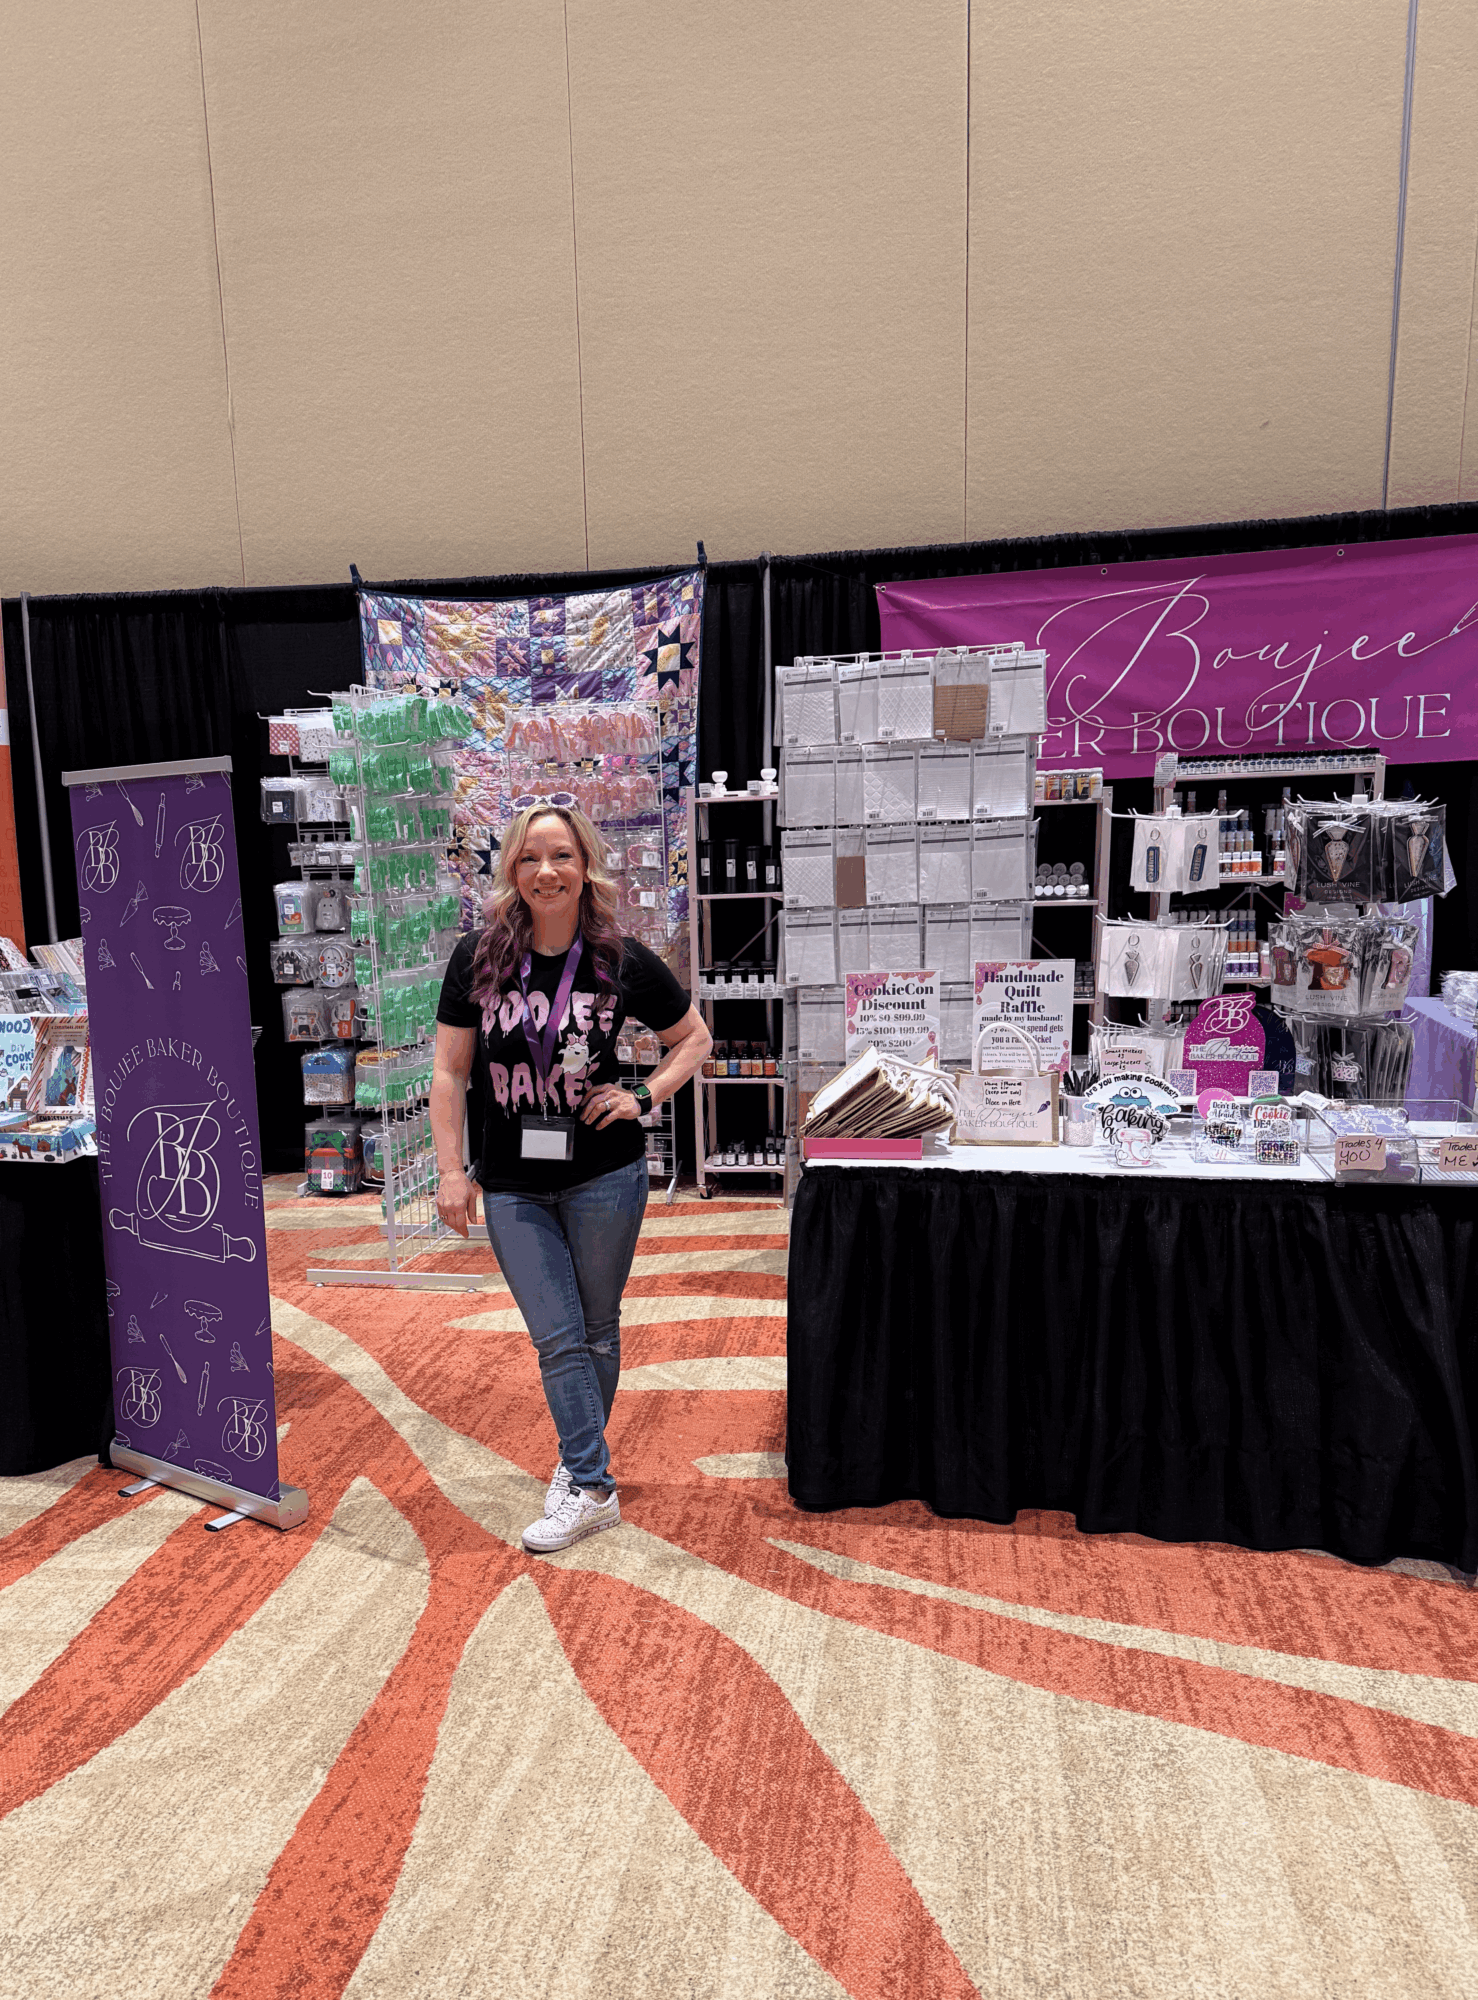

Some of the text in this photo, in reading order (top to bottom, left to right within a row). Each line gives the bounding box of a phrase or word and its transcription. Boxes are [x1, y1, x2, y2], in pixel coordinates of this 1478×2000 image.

[1037, 574, 1453, 731] Boujee
[1130, 693, 1452, 755] BOUTIQUE
[984, 970, 1064, 983] Handmade
[854, 983, 934, 997] CookieCon
[1004, 985, 1042, 1001] Quilt
[862, 999, 927, 1011] Discount
[1000, 1000, 1046, 1013] Raffle
[860, 1014, 877, 1023] 10%
[981, 1014, 1002, 1022] made
[1004, 1014, 1013, 1023] by
[1027, 1014, 1063, 1022] husband!
[856, 1027, 872, 1035] 15%
[1027, 1024, 1048, 1033] spend
[1049, 1024, 1064, 1034] gets
[991, 1035, 1004, 1044] you
[6, 1049, 34, 1067] COOKI
[1085, 1086, 1098, 1097] Are
[1098, 1077, 1112, 1089] you
[1114, 1073, 1143, 1083] making
[1213, 1101, 1230, 1109] Don't
[1255, 1105, 1289, 1121] Cookie
[101, 1037, 259, 1209] THE BOUJEE BAKER BOUTIQUE
[957, 1120, 1038, 1128] BAKER BOUTIQUE
[1262, 1142, 1295, 1151] COOKIE
[1339, 1138, 1384, 1150] Trades 4
[1443, 1142, 1477, 1151] Trades
[1444, 1155, 1467, 1166] ME
